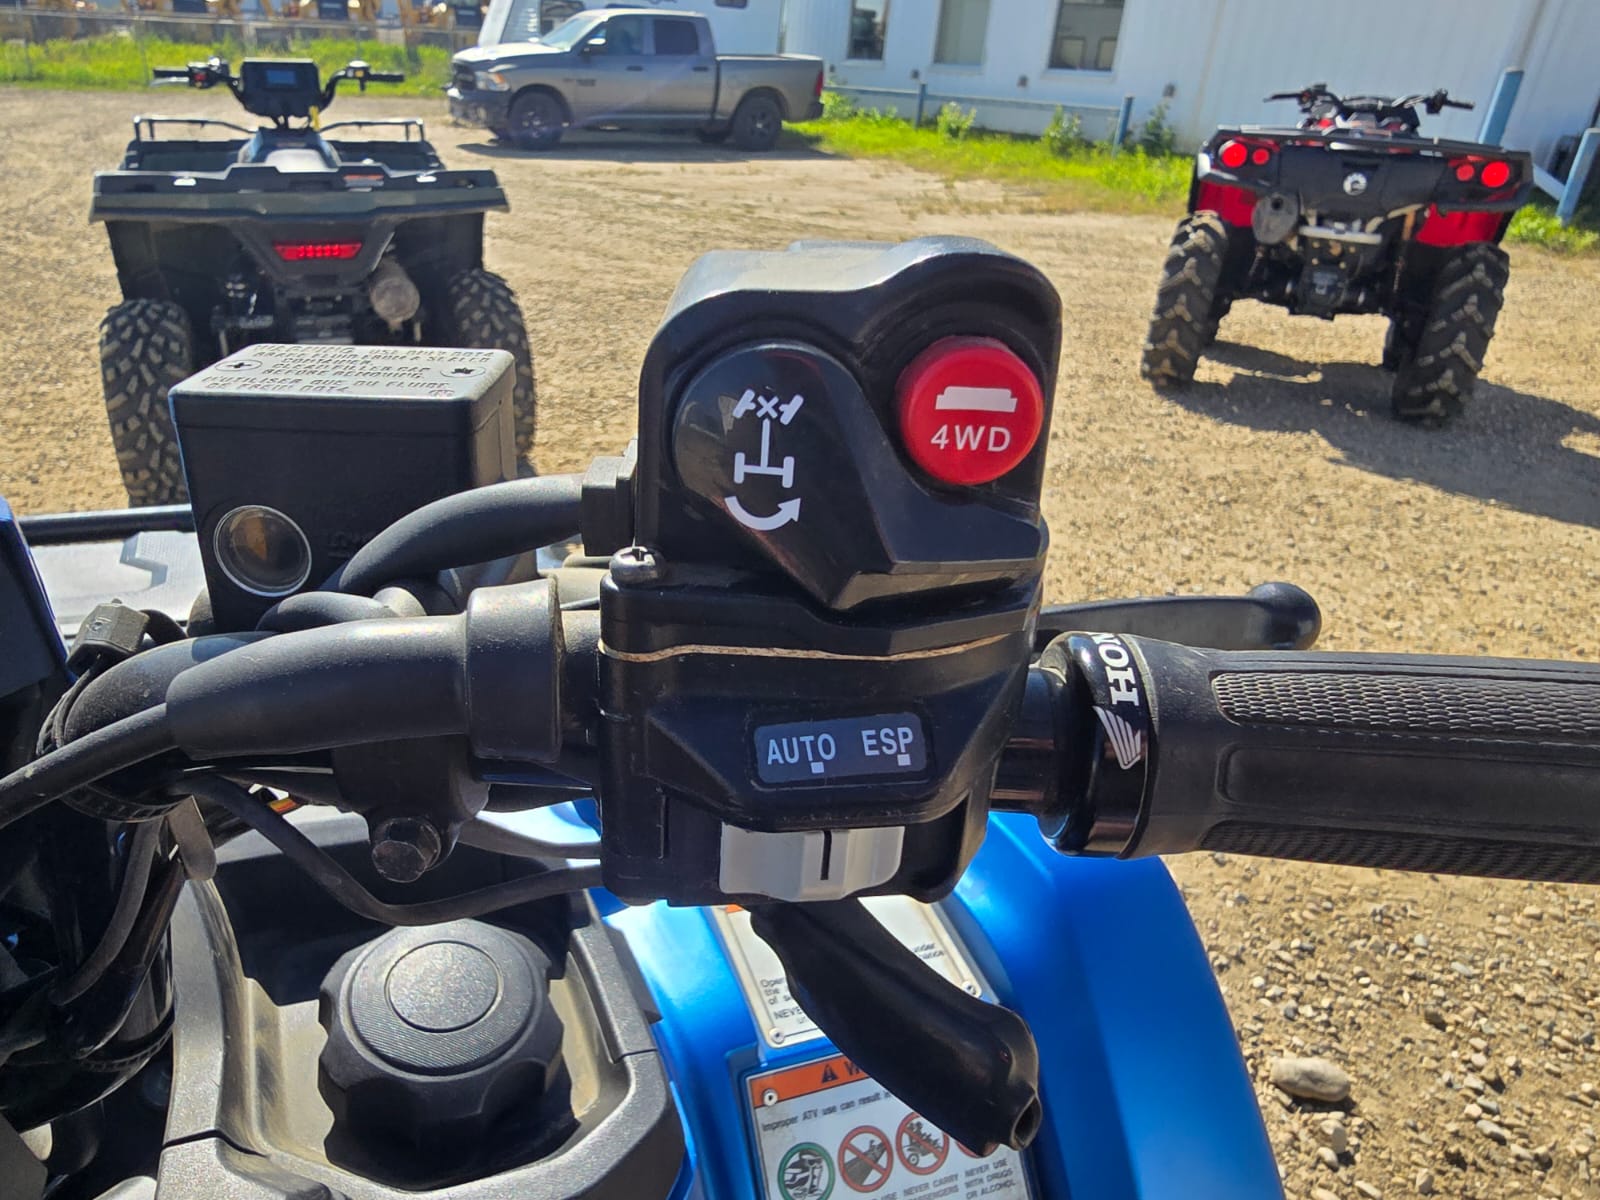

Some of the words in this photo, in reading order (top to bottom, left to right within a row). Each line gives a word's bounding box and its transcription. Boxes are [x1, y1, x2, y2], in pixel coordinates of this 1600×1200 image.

[930, 424, 1011, 452] 4WD
[767, 733, 836, 765] AUTO
[861, 727, 913, 756] ESP
[762, 1115, 798, 1131] Improper
[802, 1108, 819, 1121] ATV
[965, 1164, 990, 1177] NEVER
[993, 1158, 1008, 1169] USE
[986, 1168, 1014, 1182] DRUGS
[903, 1182, 930, 1196] NEVER
[932, 1173, 959, 1187] CARRY
[981, 1179, 1016, 1195] ALCOHOL
